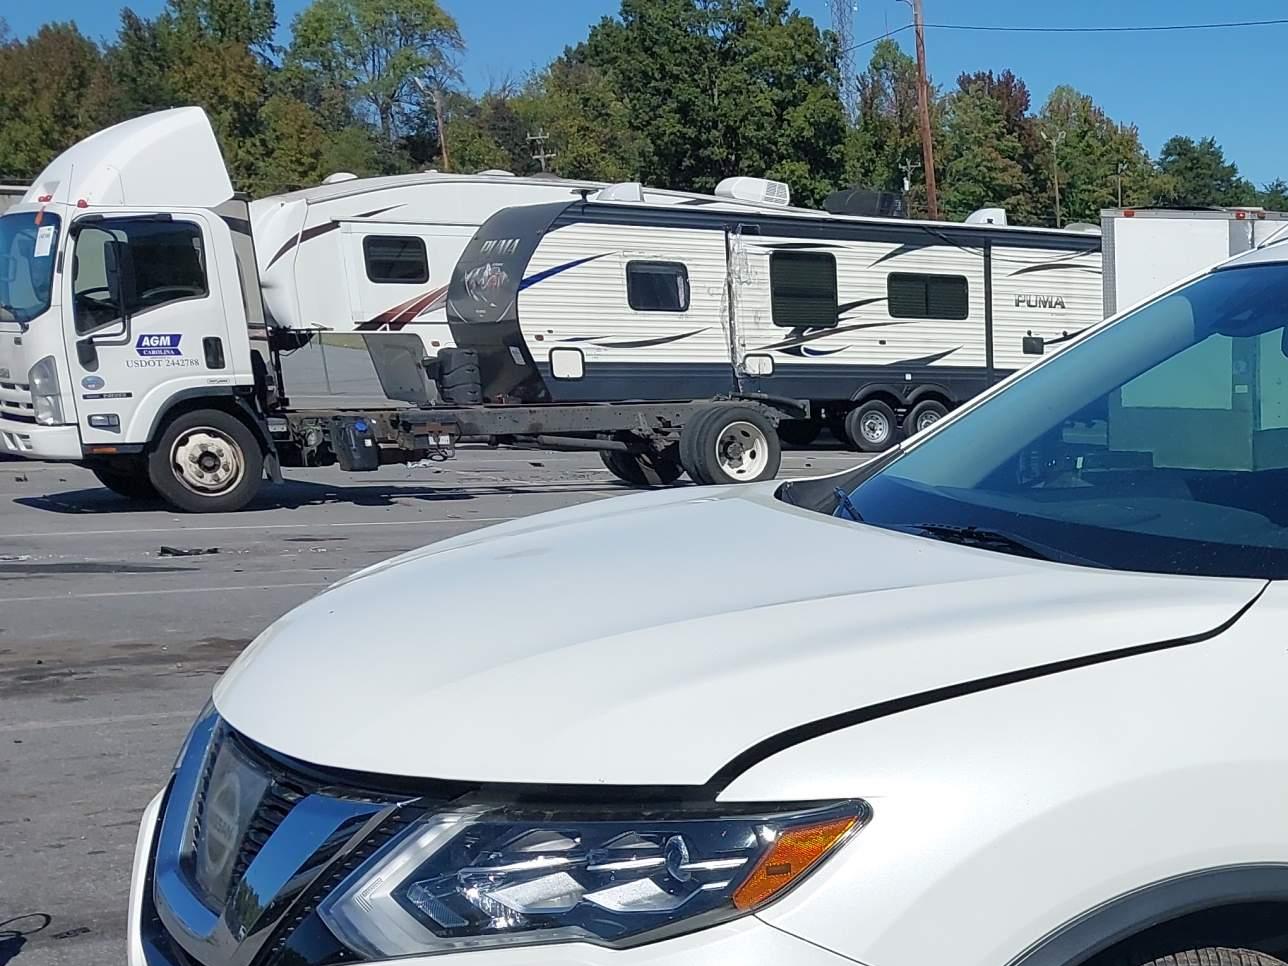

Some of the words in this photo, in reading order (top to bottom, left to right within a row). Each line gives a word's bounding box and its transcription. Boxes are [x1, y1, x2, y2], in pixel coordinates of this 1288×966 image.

[1014, 294, 1066, 309] PUMA
[141, 335, 171, 347] AGM
[126, 359, 163, 368] USDOT
[165, 358, 200, 367] 2442788
